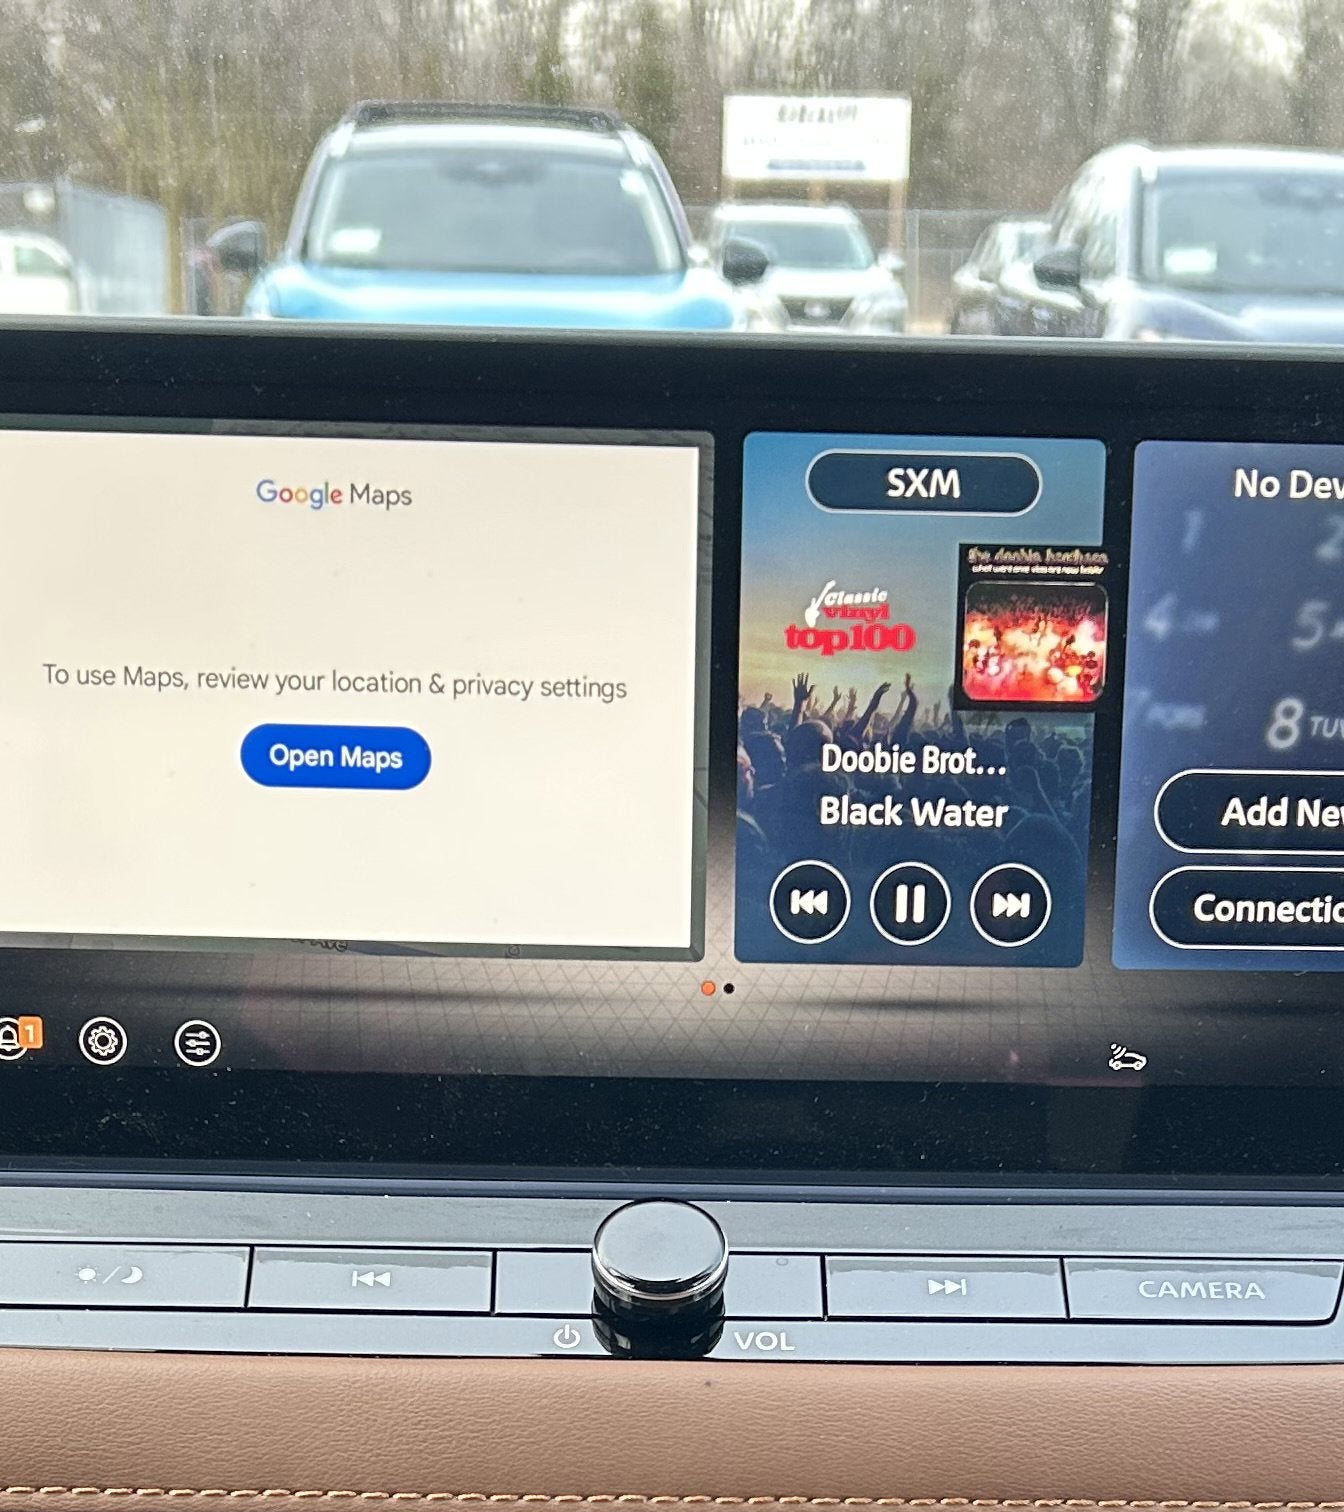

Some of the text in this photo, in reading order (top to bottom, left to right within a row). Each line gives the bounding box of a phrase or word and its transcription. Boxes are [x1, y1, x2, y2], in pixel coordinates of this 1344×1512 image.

[255, 479, 413, 511] Google Maps
[886, 467, 961, 499] SXM
[1234, 468, 1281, 498] No
[42, 663, 628, 704] To use Maps, review your location & privacy settings
[269, 743, 403, 774] Open Maps
[821, 742, 917, 774] Doobie
[820, 794, 1010, 828] Black Water
[1220, 796, 1289, 827] Add
[24, 1024, 34, 1043] 1
[1137, 1279, 1266, 1301] CAMERA
[733, 1330, 796, 1353] VOL
